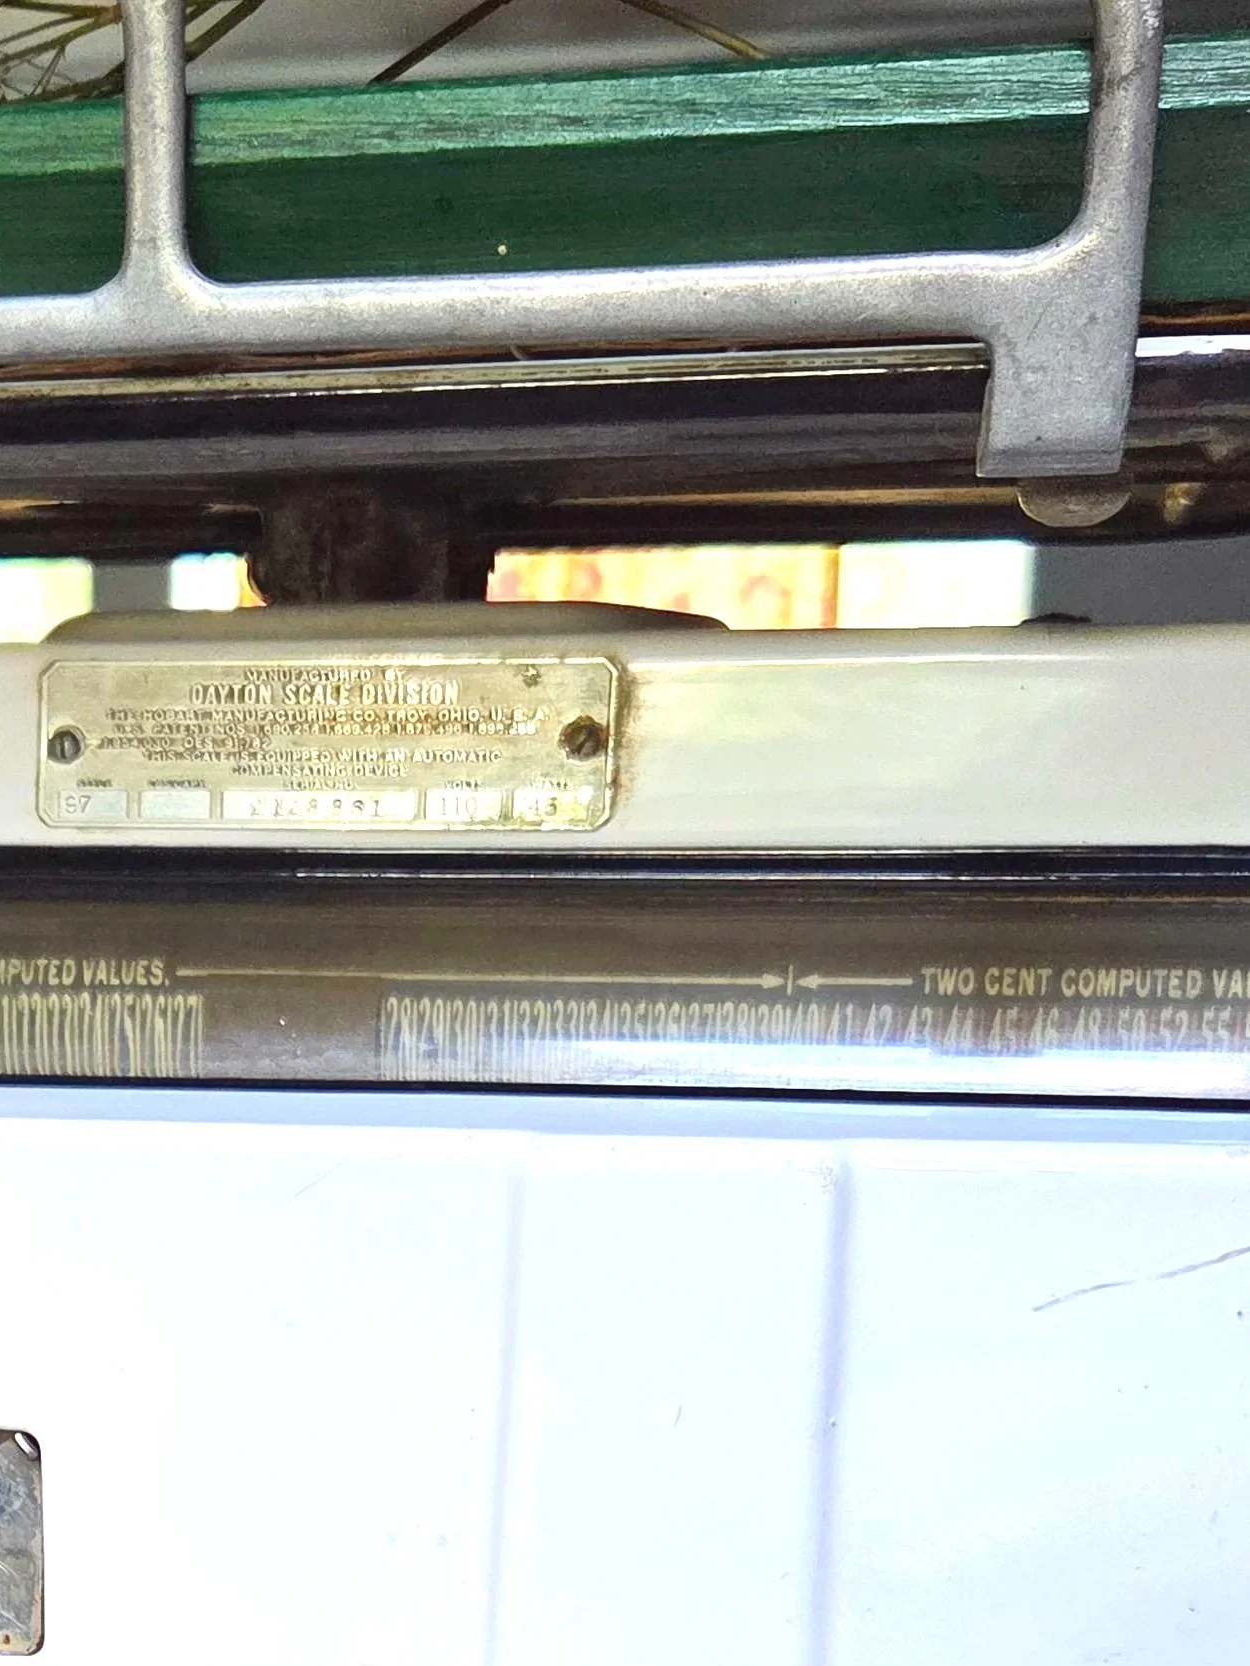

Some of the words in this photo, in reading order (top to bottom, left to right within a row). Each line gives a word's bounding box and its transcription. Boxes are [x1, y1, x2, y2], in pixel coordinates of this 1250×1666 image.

[244, 667, 371, 684] MANUFACTURED
[384, 667, 406, 681] BY
[192, 684, 272, 706] DAYTON
[284, 682, 353, 706] SCALE
[362, 680, 460, 706] DIVISION
[211, 708, 347, 722] MANUFACTURING
[142, 751, 177, 762] THIS
[183, 751, 228, 762] SCALE
[234, 750, 249, 762] IS
[256, 750, 332, 763] EQUIPPED
[338, 749, 379, 763] WITH
[385, 749, 406, 763] AN
[412, 749, 502, 763] AUTOMATIC
[230, 764, 348, 777] COMPENSATING
[353, 764, 409, 777] DEVICE
[921, 966, 975, 997] TWO
[984, 966, 1052, 997] CENT
[1060, 967, 1203, 999] COMPUTED
[1211, 967, 1250, 999] VA
